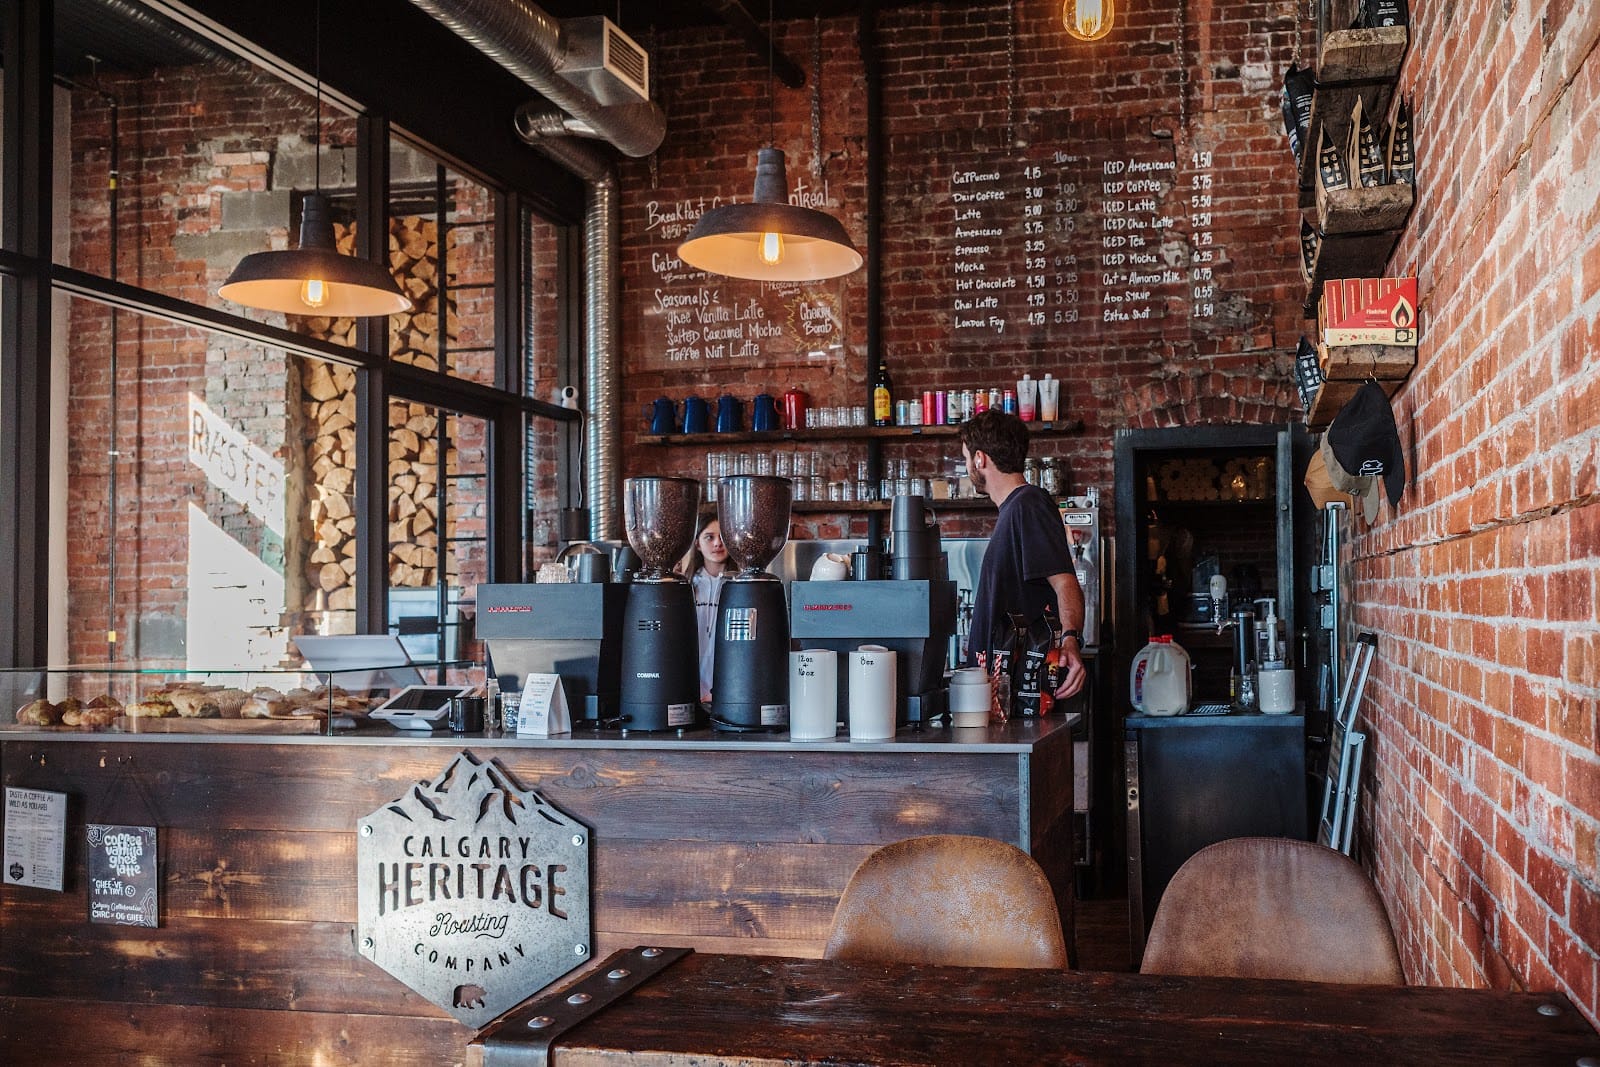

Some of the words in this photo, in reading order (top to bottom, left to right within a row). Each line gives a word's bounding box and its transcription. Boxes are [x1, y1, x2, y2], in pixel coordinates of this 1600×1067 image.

[1104, 161, 1125, 175] ICED
[1192, 151, 1212, 169] 4.50
[1025, 187, 1043, 199] 3.00
[1104, 182, 1124, 194] ICED
[1127, 180, 1161, 193] Coffee
[1192, 175, 1212, 190] 3.75
[955, 209, 981, 221] Latte
[1024, 204, 1042, 217] 5.00
[1103, 200, 1124, 213] ICED
[1127, 199, 1156, 212] Latte
[1191, 196, 1212, 208] 5.50
[1024, 221, 1044, 234] 3.75
[1103, 218, 1126, 230] ICED
[1151, 216, 1174, 228] Latte
[1192, 213, 1211, 228] 5.50
[1025, 240, 1045, 252] 3.25
[1103, 236, 1126, 248] ICED
[1128, 234, 1145, 247] Tea
[954, 261, 985, 273] Mocha
[1025, 257, 1046, 269] 5.25
[1103, 253, 1125, 265] ICED
[1129, 252, 1158, 264] Mocha
[1193, 251, 1213, 263] 6.25
[956, 278, 974, 291] Hot
[976, 276, 1016, 290] Chocolate
[1026, 275, 1045, 288] 4.50
[1103, 272, 1119, 285] Oat
[1193, 268, 1212, 280] 0.75
[653, 287, 709, 314] Seasonals
[1194, 286, 1213, 298] 0.55
[695, 306, 729, 324] Vanilla
[734, 298, 764, 320] Latte
[954, 299, 972, 311] Chai
[976, 296, 998, 309] Latte
[1193, 303, 1214, 317] 1.50
[989, 316, 1005, 333] Fog
[1055, 309, 1079, 324] 5.50
[703, 322, 743, 342] Caramel
[748, 320, 782, 339] Mocha
[705, 344, 725, 359] Nut
[729, 339, 760, 357] Latte
[104, 833, 143, 846] coffee
[403, 835, 530, 859] CALGARY
[109, 854, 137, 868] ghee
[116, 864, 142, 877] latte
[378, 862, 568, 920] HERITAGE
[429, 912, 509, 939] Roasting
[414, 942, 526, 972] COMPANY
